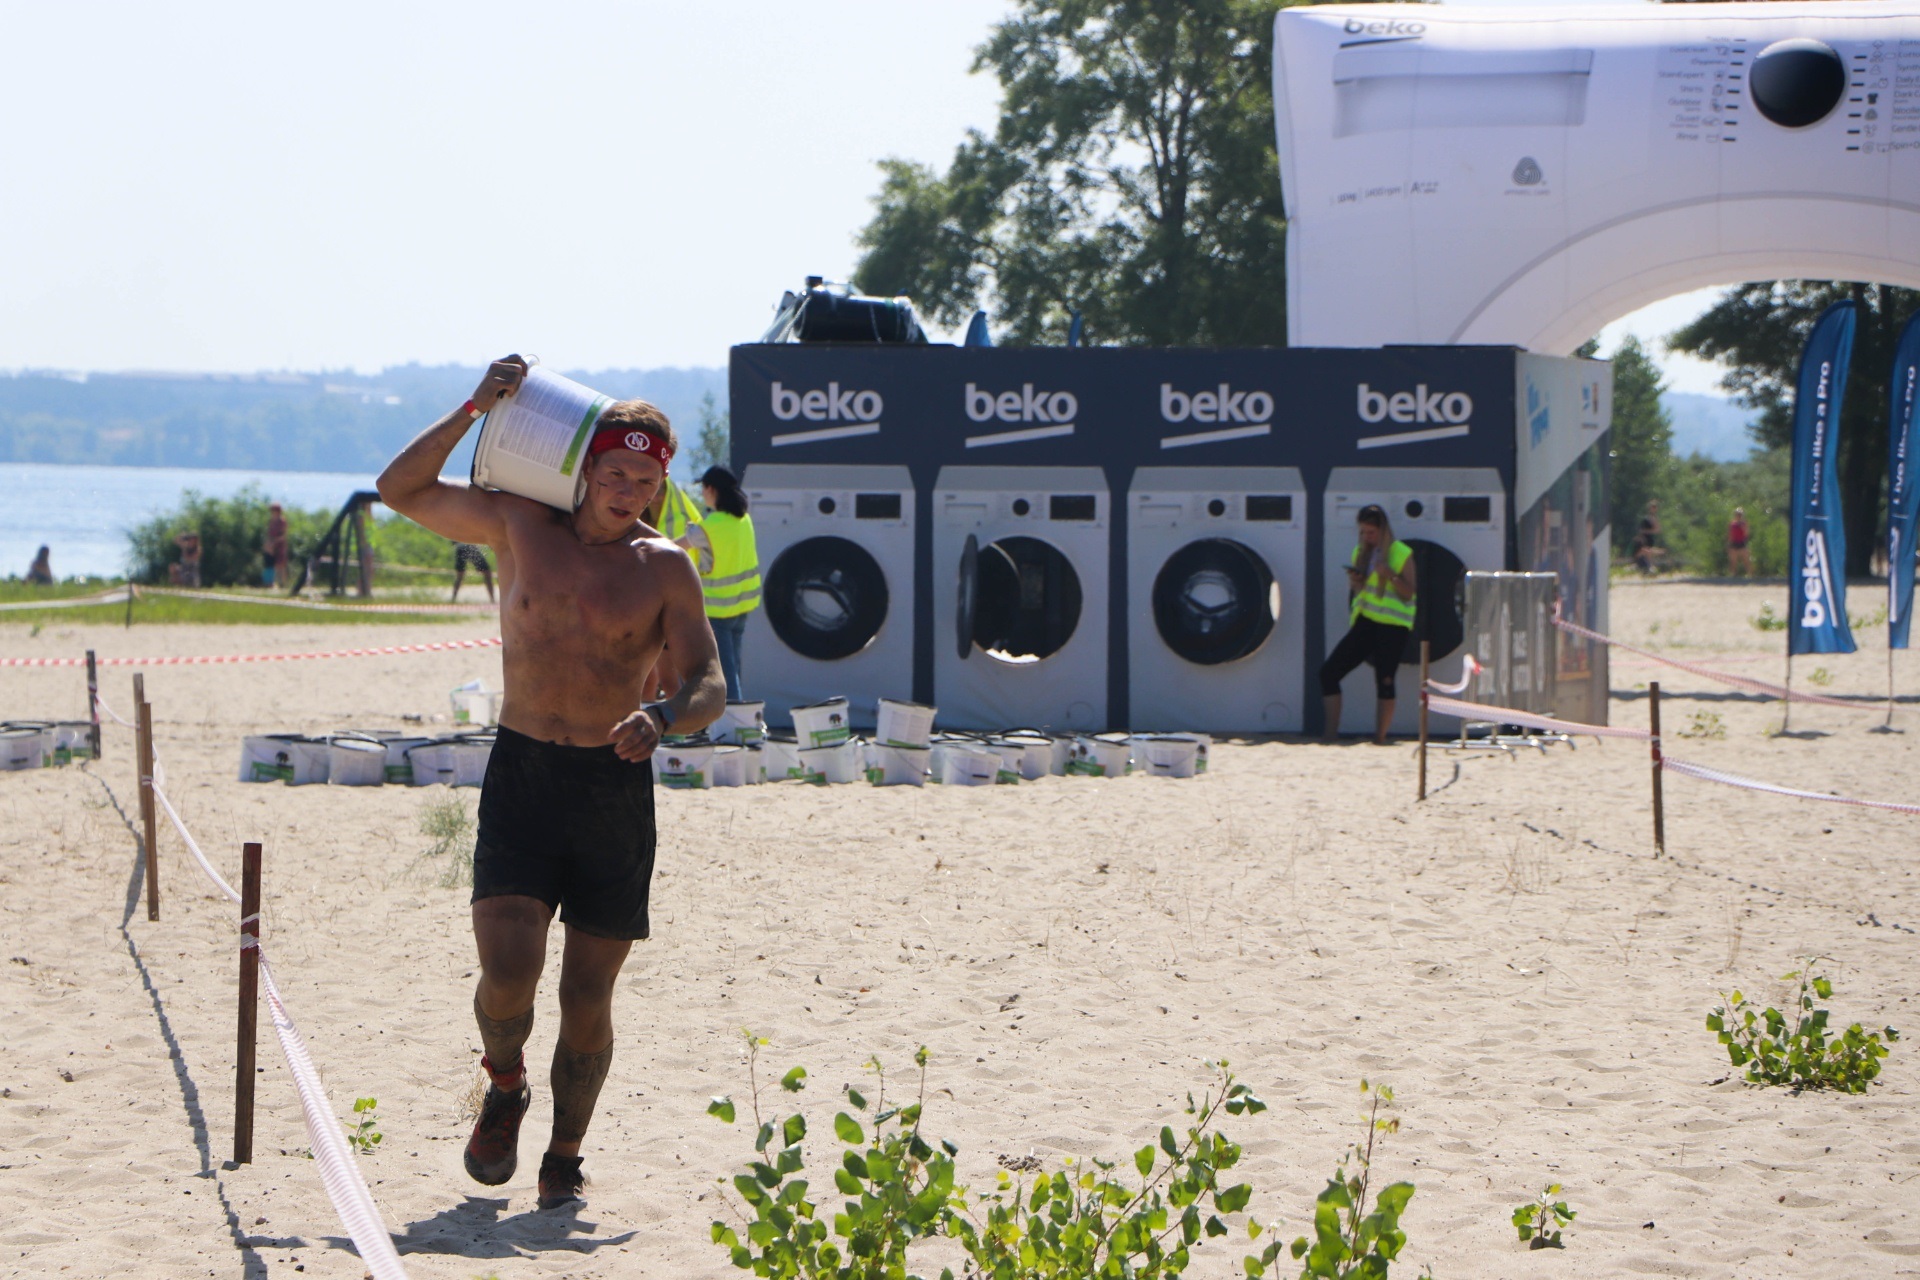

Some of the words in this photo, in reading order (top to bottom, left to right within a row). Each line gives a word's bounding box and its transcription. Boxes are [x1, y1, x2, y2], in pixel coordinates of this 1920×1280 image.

[1343, 17, 1427, 35] beko
[1816, 362, 1831, 399] Pro
[1905, 366, 1917, 401] Pro
[771, 381, 884, 422] beko
[965, 382, 1078, 423] beko
[1160, 383, 1275, 424] beko
[1356, 383, 1473, 424] beko
[1816, 404, 1827, 417] a
[1812, 421, 1825, 458] like
[1801, 529, 1825, 628] beko
